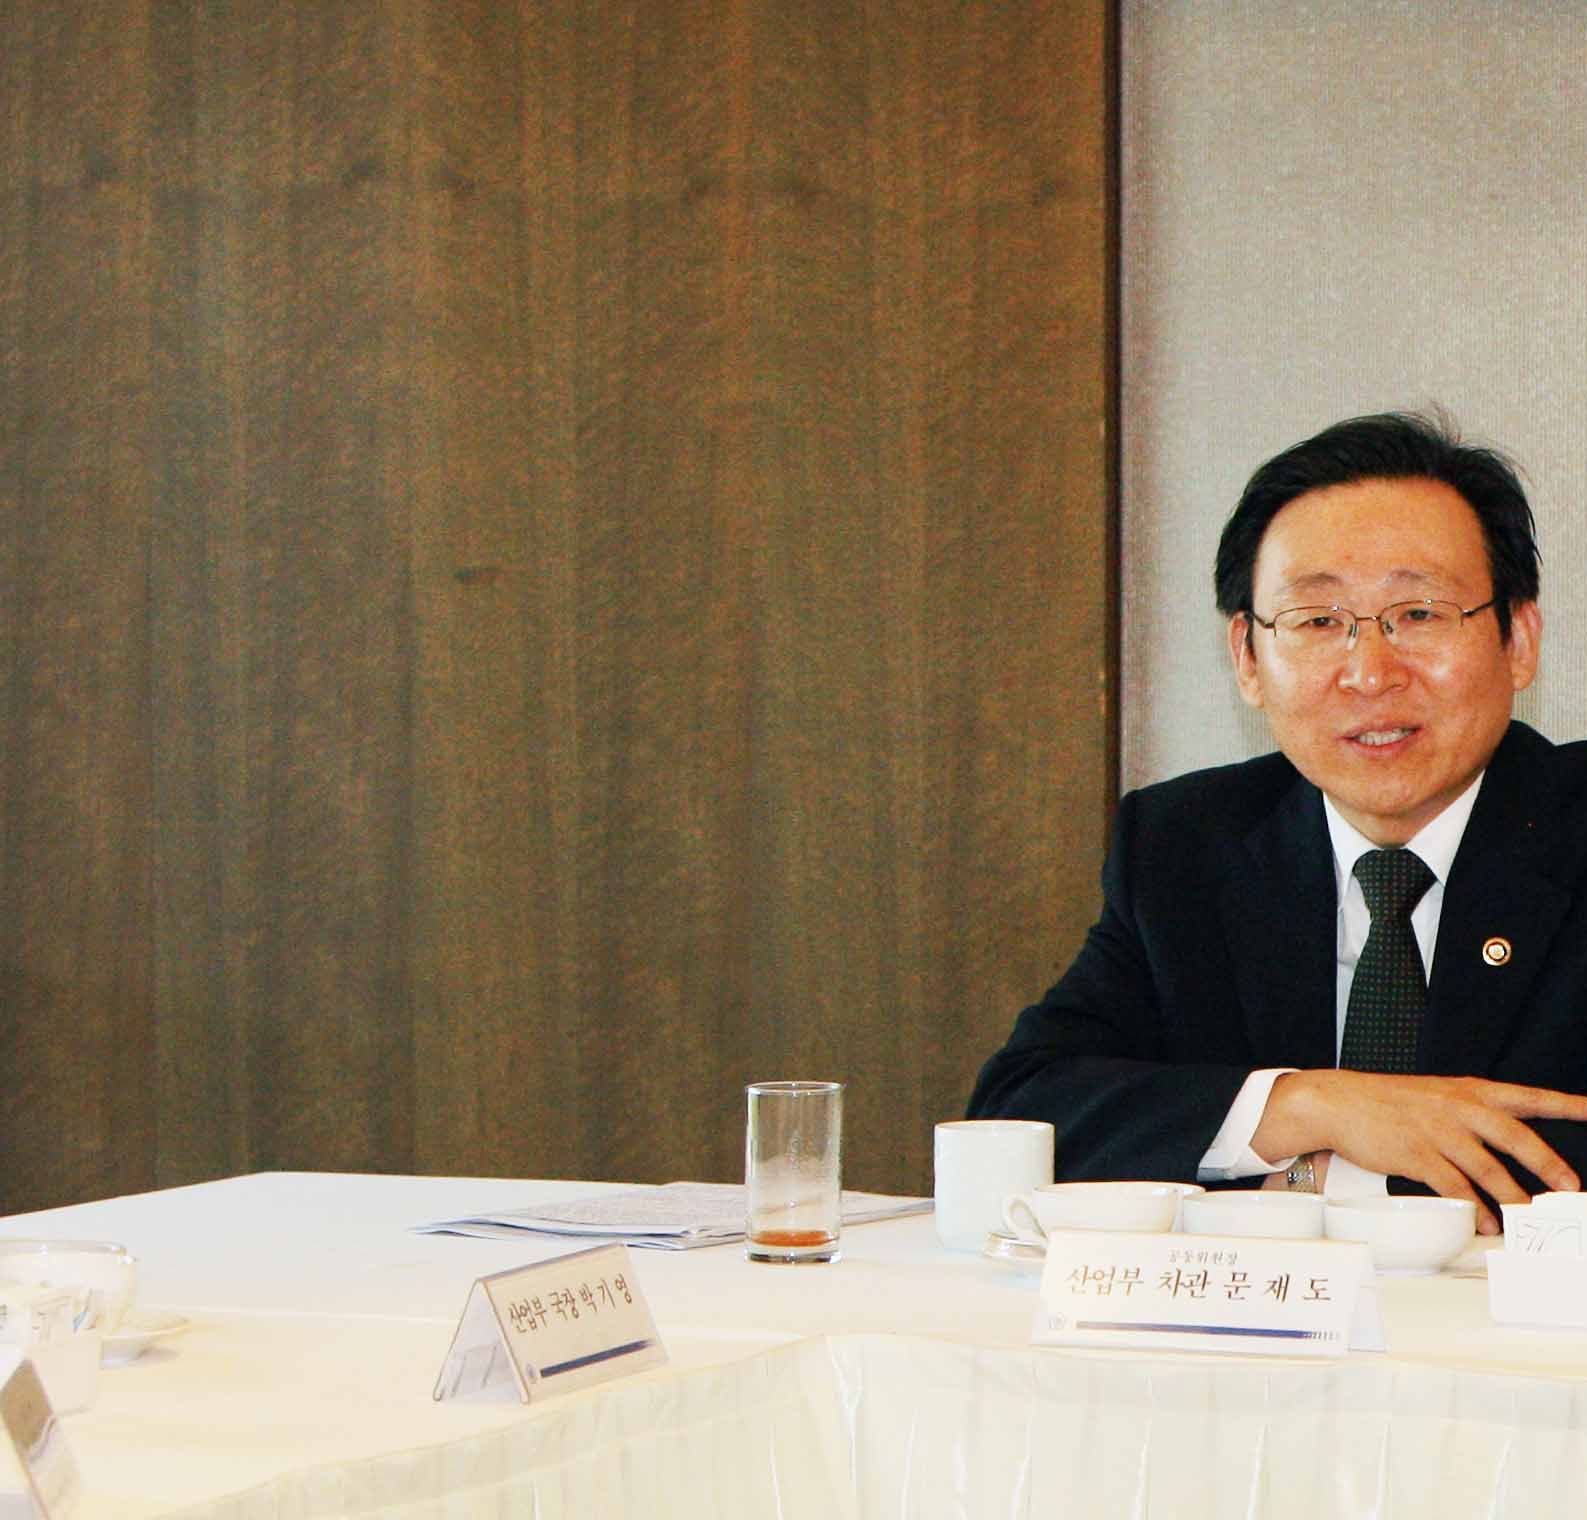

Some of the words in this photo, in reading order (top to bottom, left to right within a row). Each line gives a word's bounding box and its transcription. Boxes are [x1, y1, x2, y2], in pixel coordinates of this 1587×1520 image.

[1064, 1264, 1145, 1297] 산업부
[1159, 1267, 1212, 1300] 차관
[1223, 1271, 1252, 1301] 문
[1263, 1273, 1291, 1304] 재
[1302, 1277, 1331, 1302] 도
[508, 1295, 548, 1333] 산업부
[547, 1287, 580, 1321] 국장
